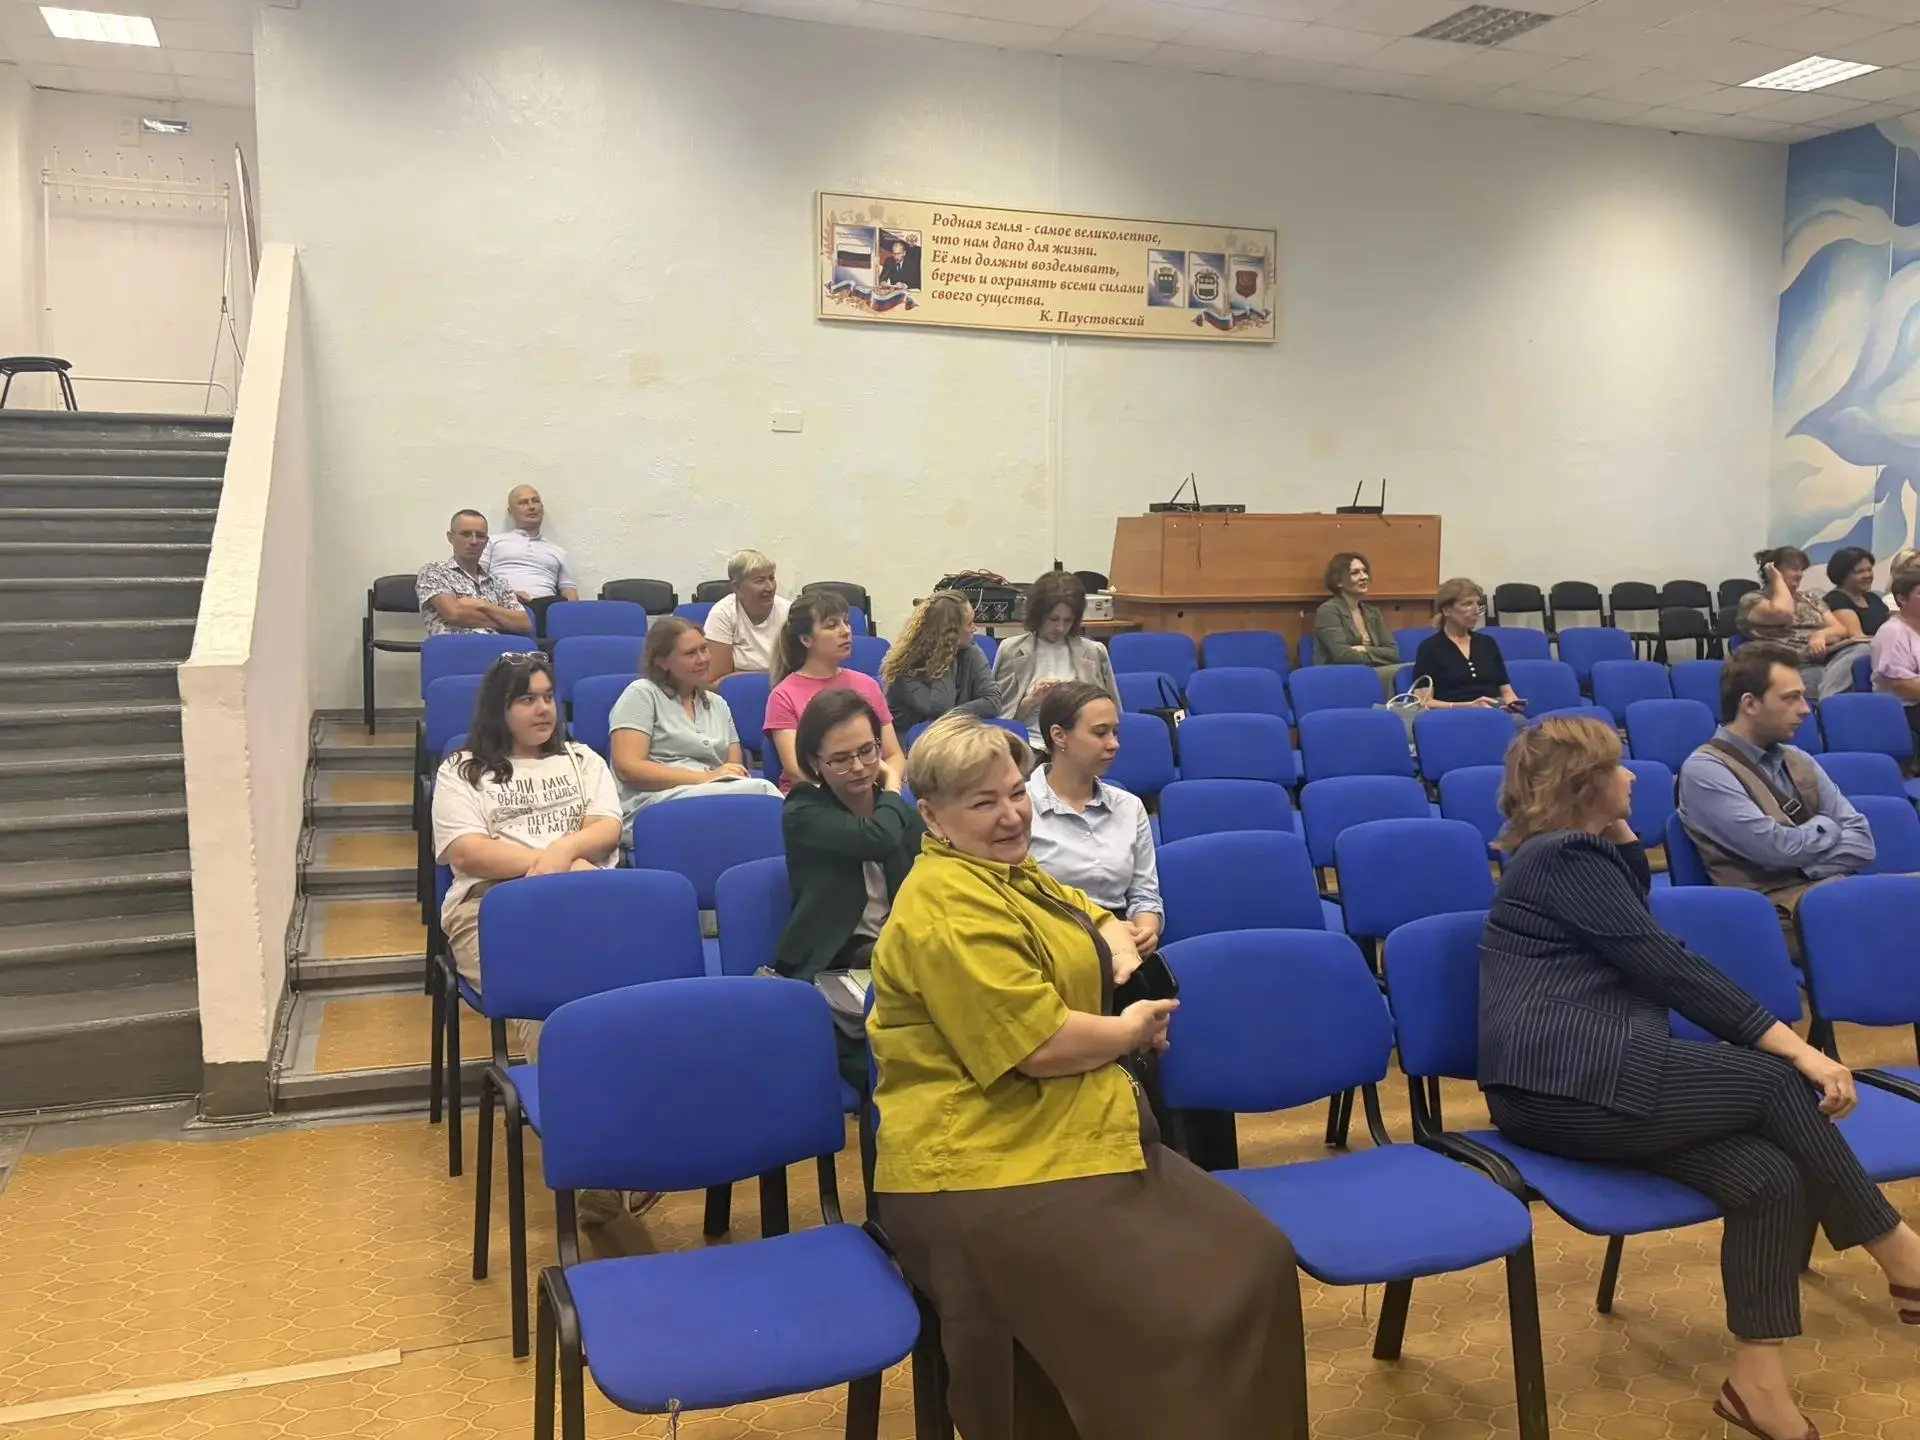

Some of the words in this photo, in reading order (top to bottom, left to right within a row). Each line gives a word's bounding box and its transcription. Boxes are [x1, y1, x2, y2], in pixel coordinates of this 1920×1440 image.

[932, 212, 982, 230] Родная
[985, 218, 1023, 233] земля
[1034, 224, 1071, 237] самое
[1074, 228, 1162, 245] великолепное,
[932, 235, 960, 247] что
[963, 237, 989, 249] нам
[992, 235, 1024, 251] дано
[1027, 237, 1050, 254] для
[1052, 243, 1097, 257] жизни.
[932, 249, 948, 263] Её
[950, 254, 972, 265] мы
[974, 251, 1028, 270] должны
[1031, 258, 1120, 277] возделывать,
[932, 268, 976, 286] беречь
[978, 275, 988, 284] и
[990, 275, 1057, 290] охранять
[1060, 279, 1097, 292] всеми
[1099, 281, 1145, 294] силами
[932, 290, 973, 303] своего
[976, 292, 1044, 309] существа.
[1039, 310, 1053, 322] К.
[1057, 311, 1145, 327] Паустовский
[500, 777, 535, 793] ЕСЛИ
[542, 775, 571, 790] МНЕ
[543, 786, 579, 802] КРЫЛЬЯ
[528, 804, 583, 826] ПЕРЕСЯДУ
[528, 825, 541, 834] НА
